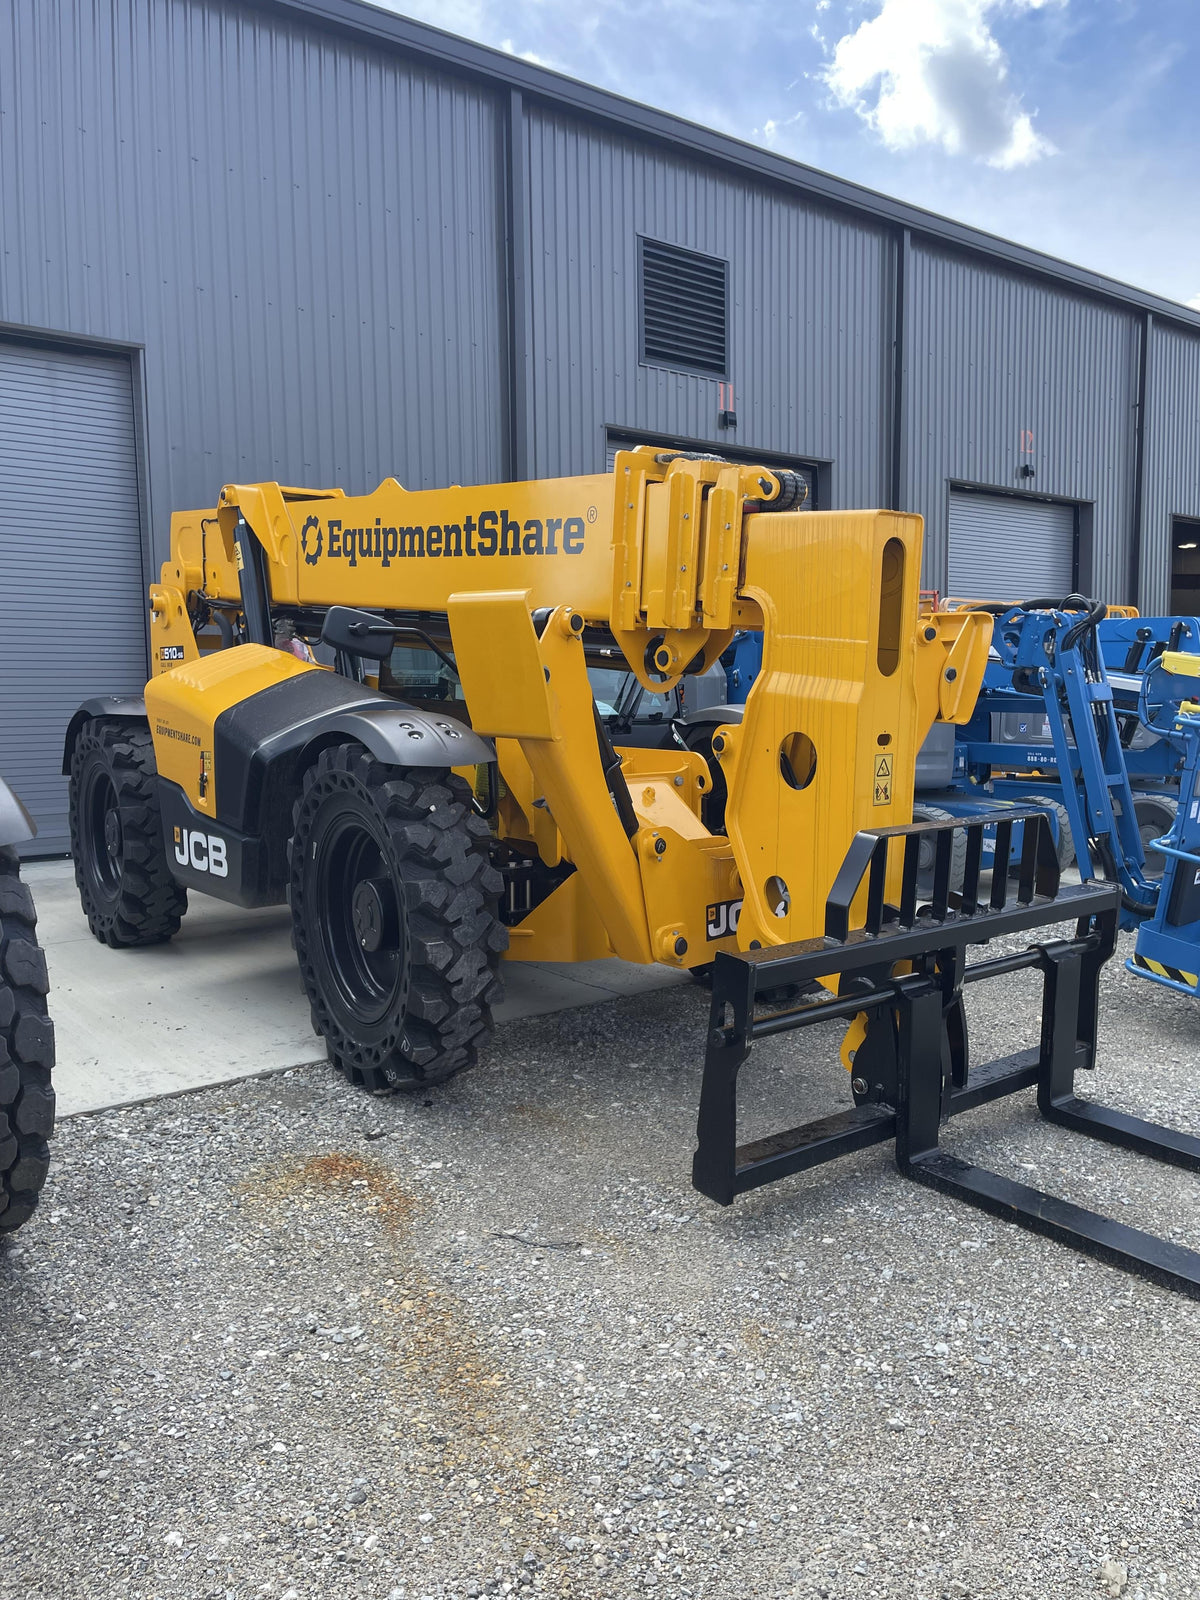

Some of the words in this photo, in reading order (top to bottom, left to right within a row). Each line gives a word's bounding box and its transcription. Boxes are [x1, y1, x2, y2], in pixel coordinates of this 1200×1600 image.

[717, 383, 735, 412] 11
[1020, 429, 1035, 453] 12
[174, 828, 229, 878] JCB
